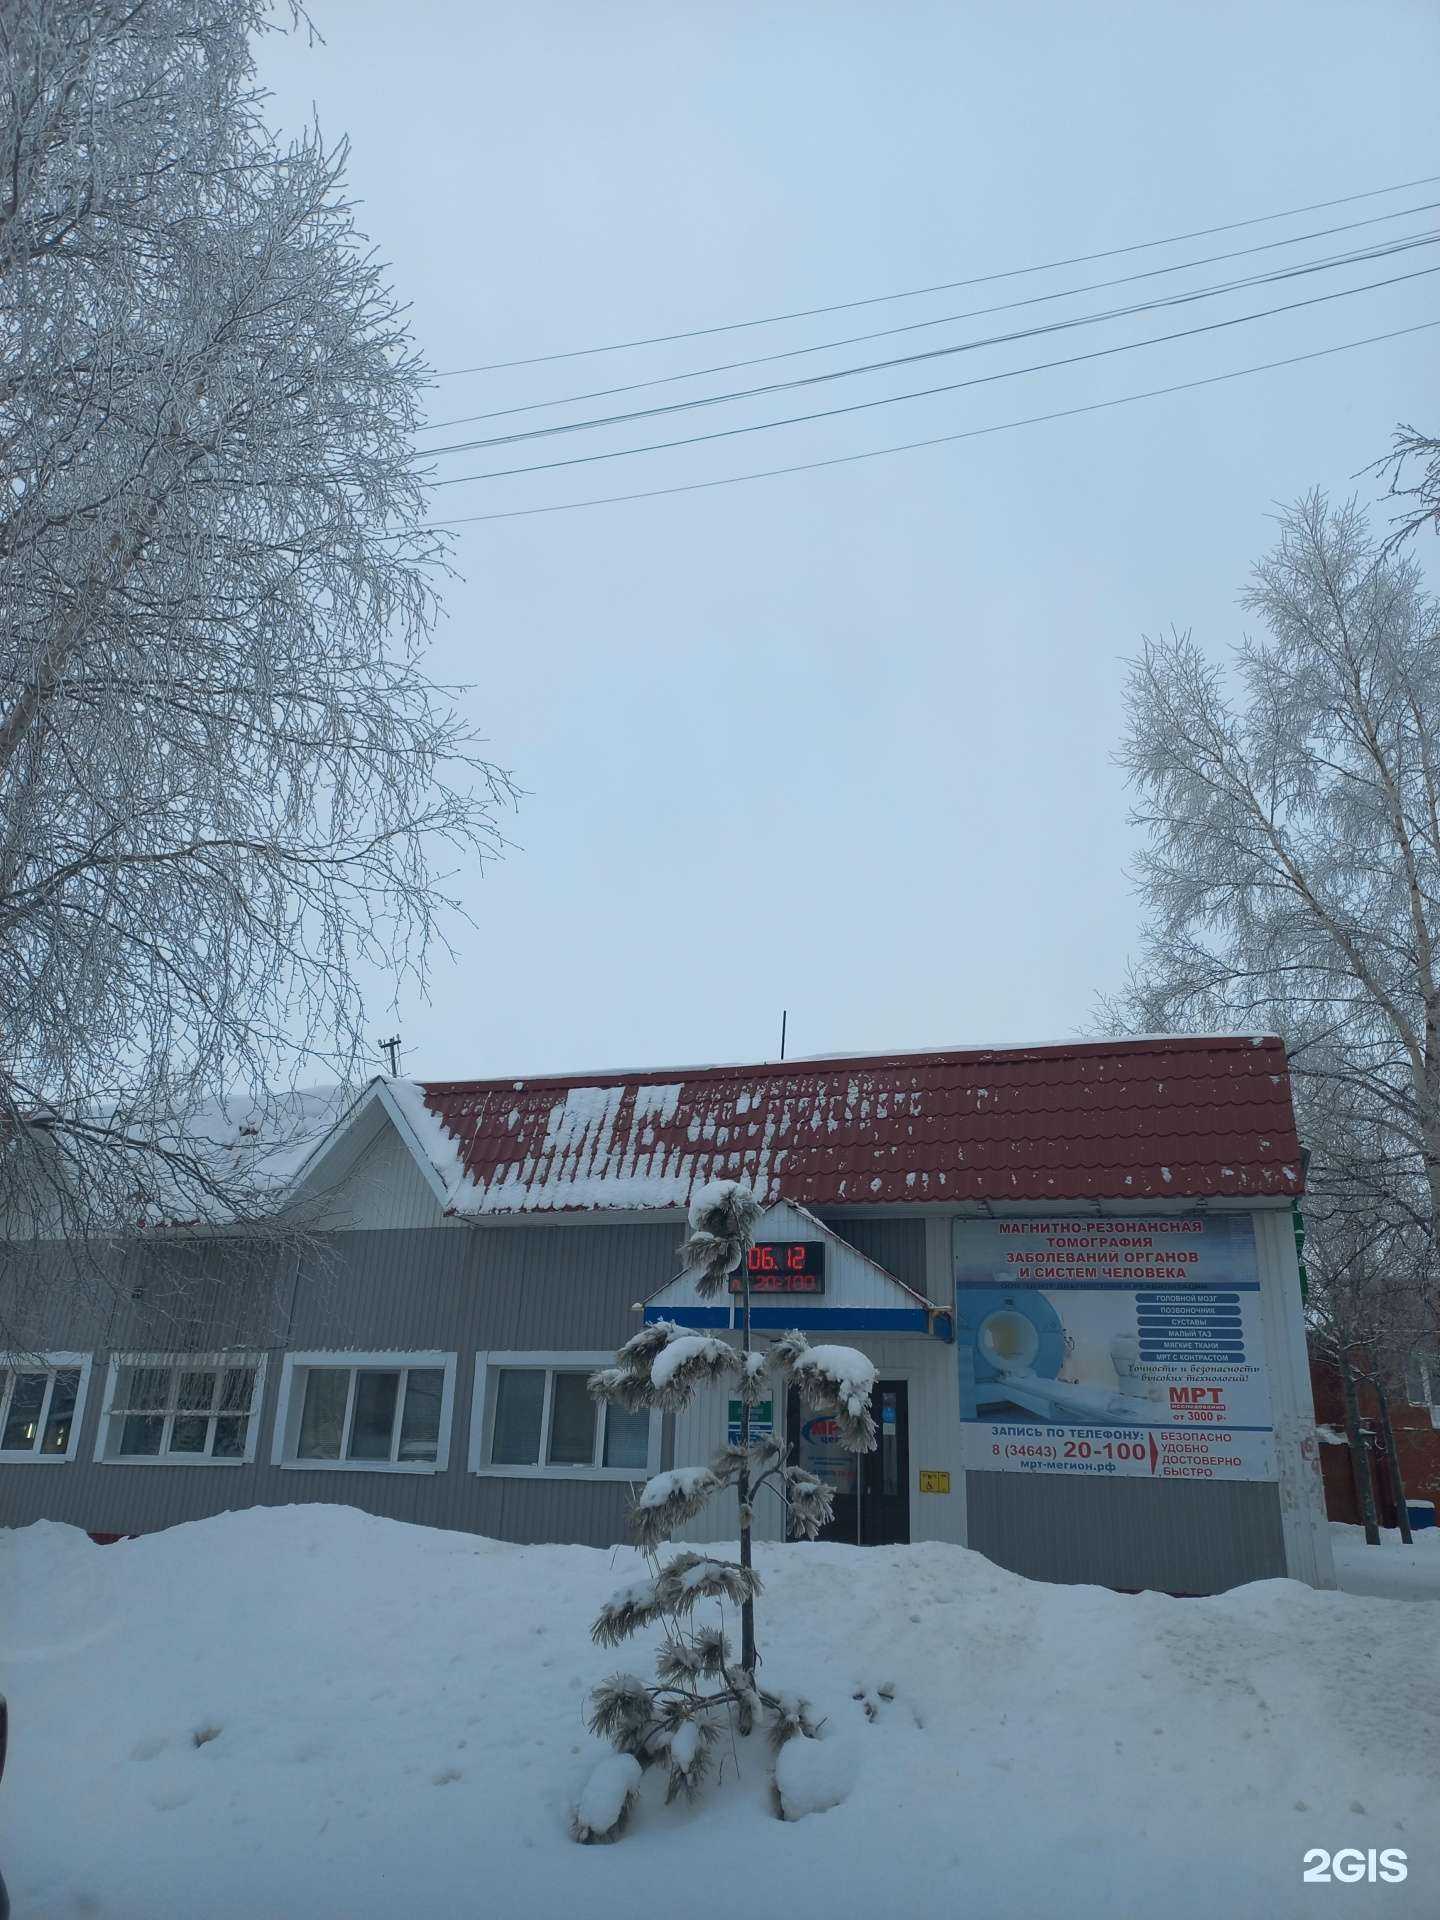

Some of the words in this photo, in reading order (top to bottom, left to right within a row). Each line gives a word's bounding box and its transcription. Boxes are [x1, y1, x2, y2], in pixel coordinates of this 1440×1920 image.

[999, 1220, 1203, 1234] МАГНИТНО-РЕЗОНАНСНАЯ
[1046, 1237, 1153, 1249] ТОМОГРАФИЯ
[1006, 1250, 1120, 1264] ЗАБОЛЕВАНИЙ
[1124, 1252, 1200, 1264] ОРГАНОВ
[1019, 1267, 1030, 1279] И
[1034, 1267, 1098, 1279] СИСТЕМ
[1102, 1267, 1187, 1279] ЧЕЛОВЕКА
[1168, 1329, 1197, 1337] МАЛЫЙ
[1190, 1365, 1260, 1375] безопасность
[1168, 1387, 1224, 1404] МРТ
[1173, 1413, 1184, 1421] от
[1187, 1411, 1214, 1421] 3000
[991, 1426, 1043, 1437] ЗАПИСЬ
[1046, 1428, 1065, 1438] ПО
[1070, 1429, 1144, 1440] ТЕЛЕФОНУ:
[1160, 1432, 1232, 1442] БЕЗОПАСНО
[992, 1444, 1000, 1456] 8
[1005, 1444, 1057, 1460] (34643)
[1063, 1441, 1146, 1460] 20-100
[1161, 1444, 1209, 1453] УДОБНО
[1020, 1460, 1117, 1473] мрт-мегион.рф
[1162, 1455, 1242, 1466] ДОСТОВЕРНО
[1163, 1467, 1213, 1477] БЫСТРО
